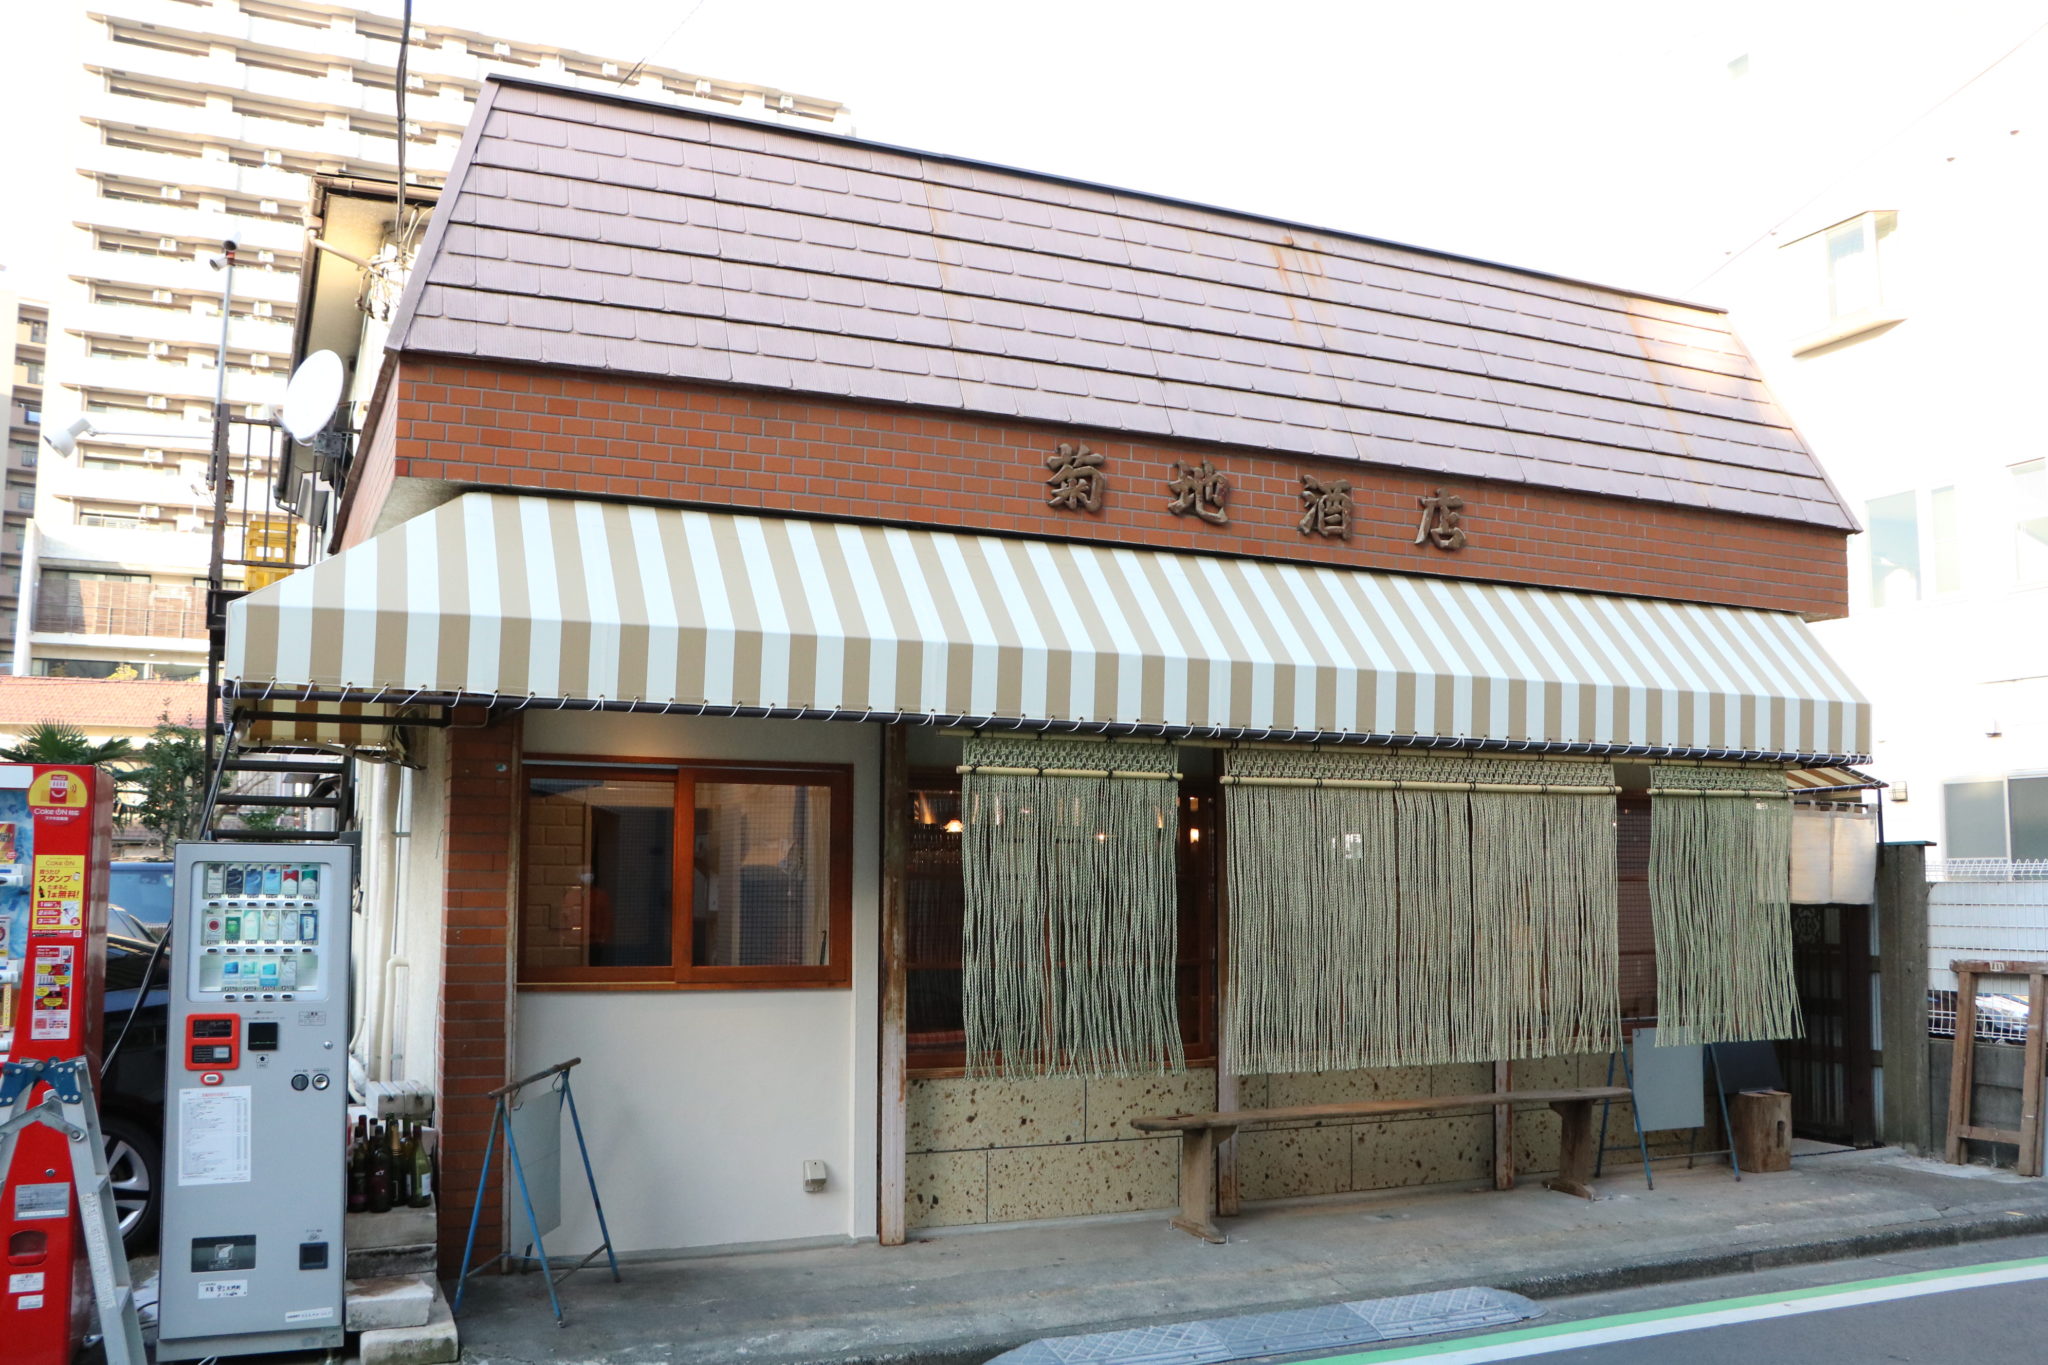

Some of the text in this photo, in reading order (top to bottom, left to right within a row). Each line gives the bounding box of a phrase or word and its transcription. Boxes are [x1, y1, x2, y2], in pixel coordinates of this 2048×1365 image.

[1046, 443, 1467, 550] 菊地酒店
[39, 875, 72, 883] スタンプ
